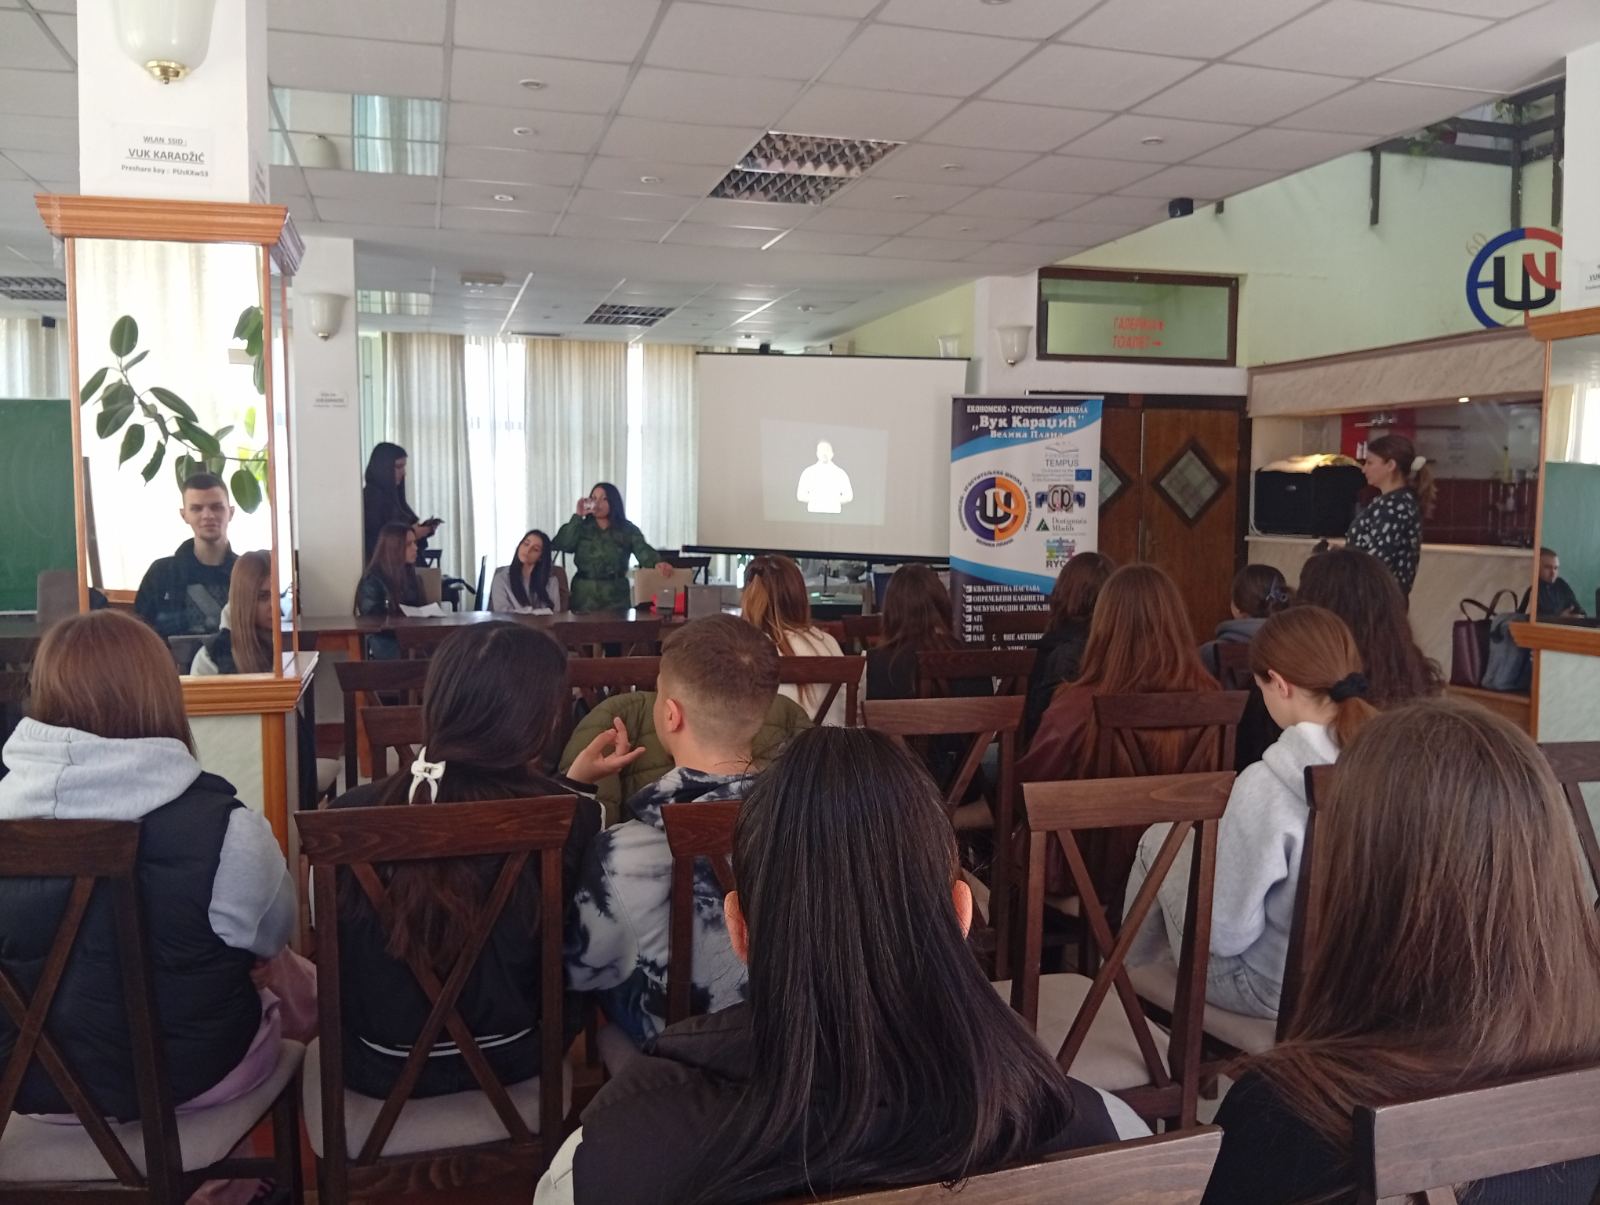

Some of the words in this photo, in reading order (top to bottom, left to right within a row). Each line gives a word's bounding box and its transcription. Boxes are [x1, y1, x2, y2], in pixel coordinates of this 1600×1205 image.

[143, 135, 165, 145] WLAN
[128, 148, 151, 159] VUK
[153, 149, 205, 163] KARADŽIĆ
[966, 404, 1007, 413] ЕКОНОМСКО
[1010, 405, 1062, 414] УГОСТИТЕЉСКА
[1063, 405, 1088, 414] ШКОЛА
[990, 430, 1027, 439] Велика
[1030, 430, 1063, 439] Плана
[1045, 458, 1079, 468] TEMPUS
[1045, 560, 1066, 568] RYC
